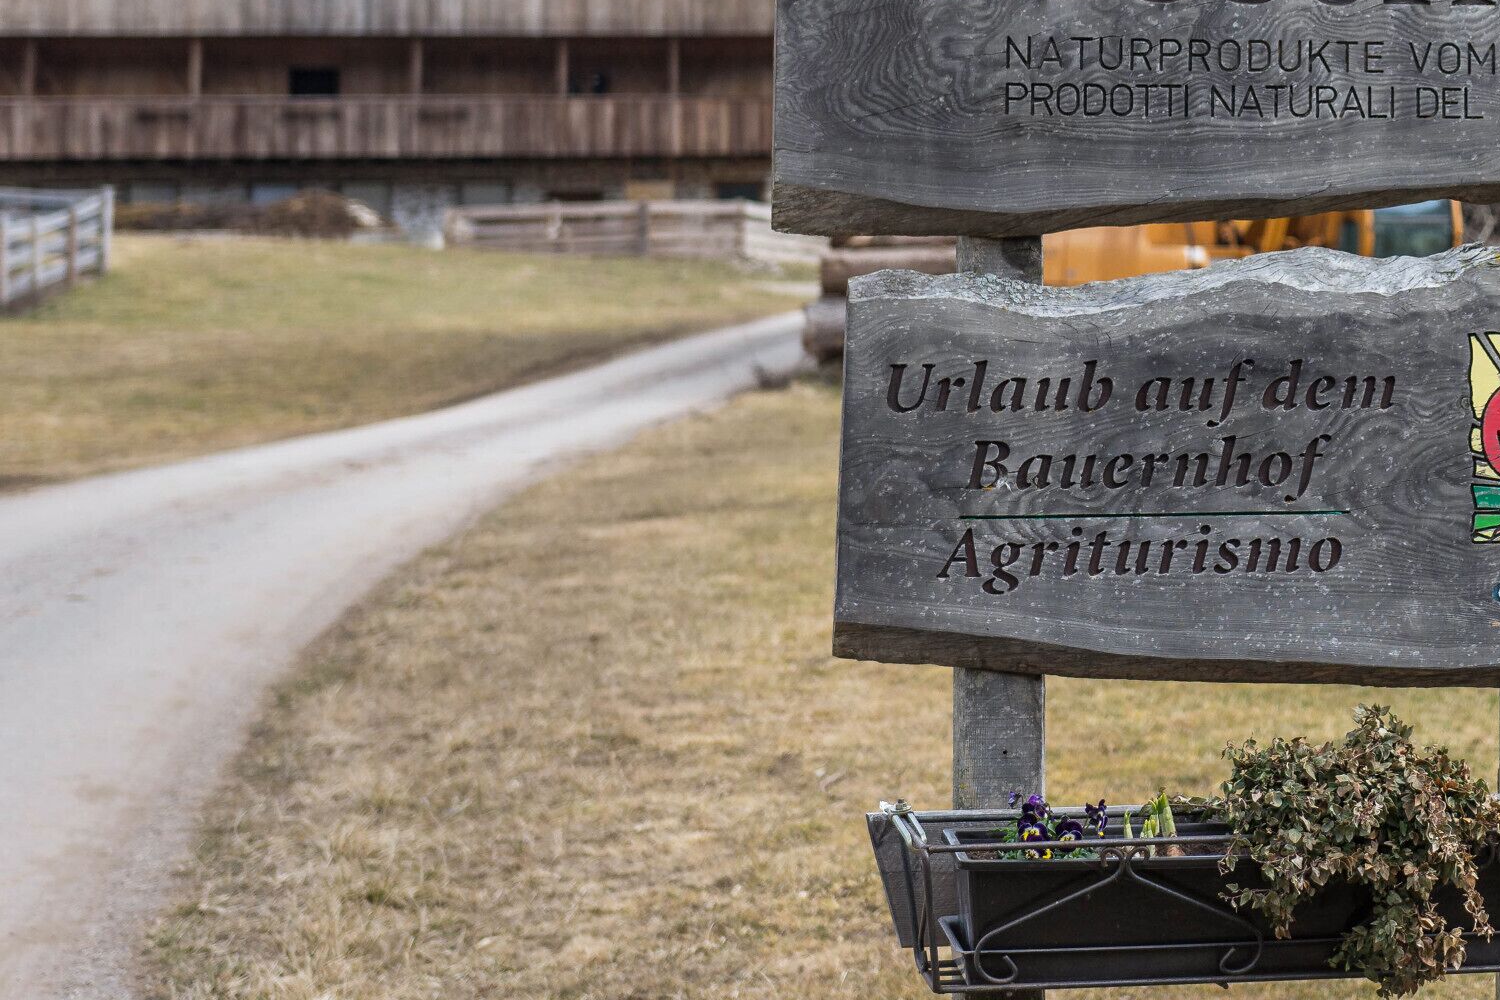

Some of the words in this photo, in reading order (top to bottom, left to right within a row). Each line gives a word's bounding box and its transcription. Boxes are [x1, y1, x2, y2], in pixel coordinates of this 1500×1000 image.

[1004, 35, 1384, 75] NATURPRODUKTE
[1409, 40, 1497, 75] VOM
[1004, 82, 1190, 119] PRODOTTI
[1210, 84, 1397, 121] NATURALI
[1417, 86, 1484, 122] DEL
[885, 359, 1115, 414] Urlaub
[1134, 358, 1256, 427] auf
[1261, 358, 1396, 411] dem
[966, 434, 1332, 502] Bauernhof
[936, 524, 1344, 595] Agriturismo
